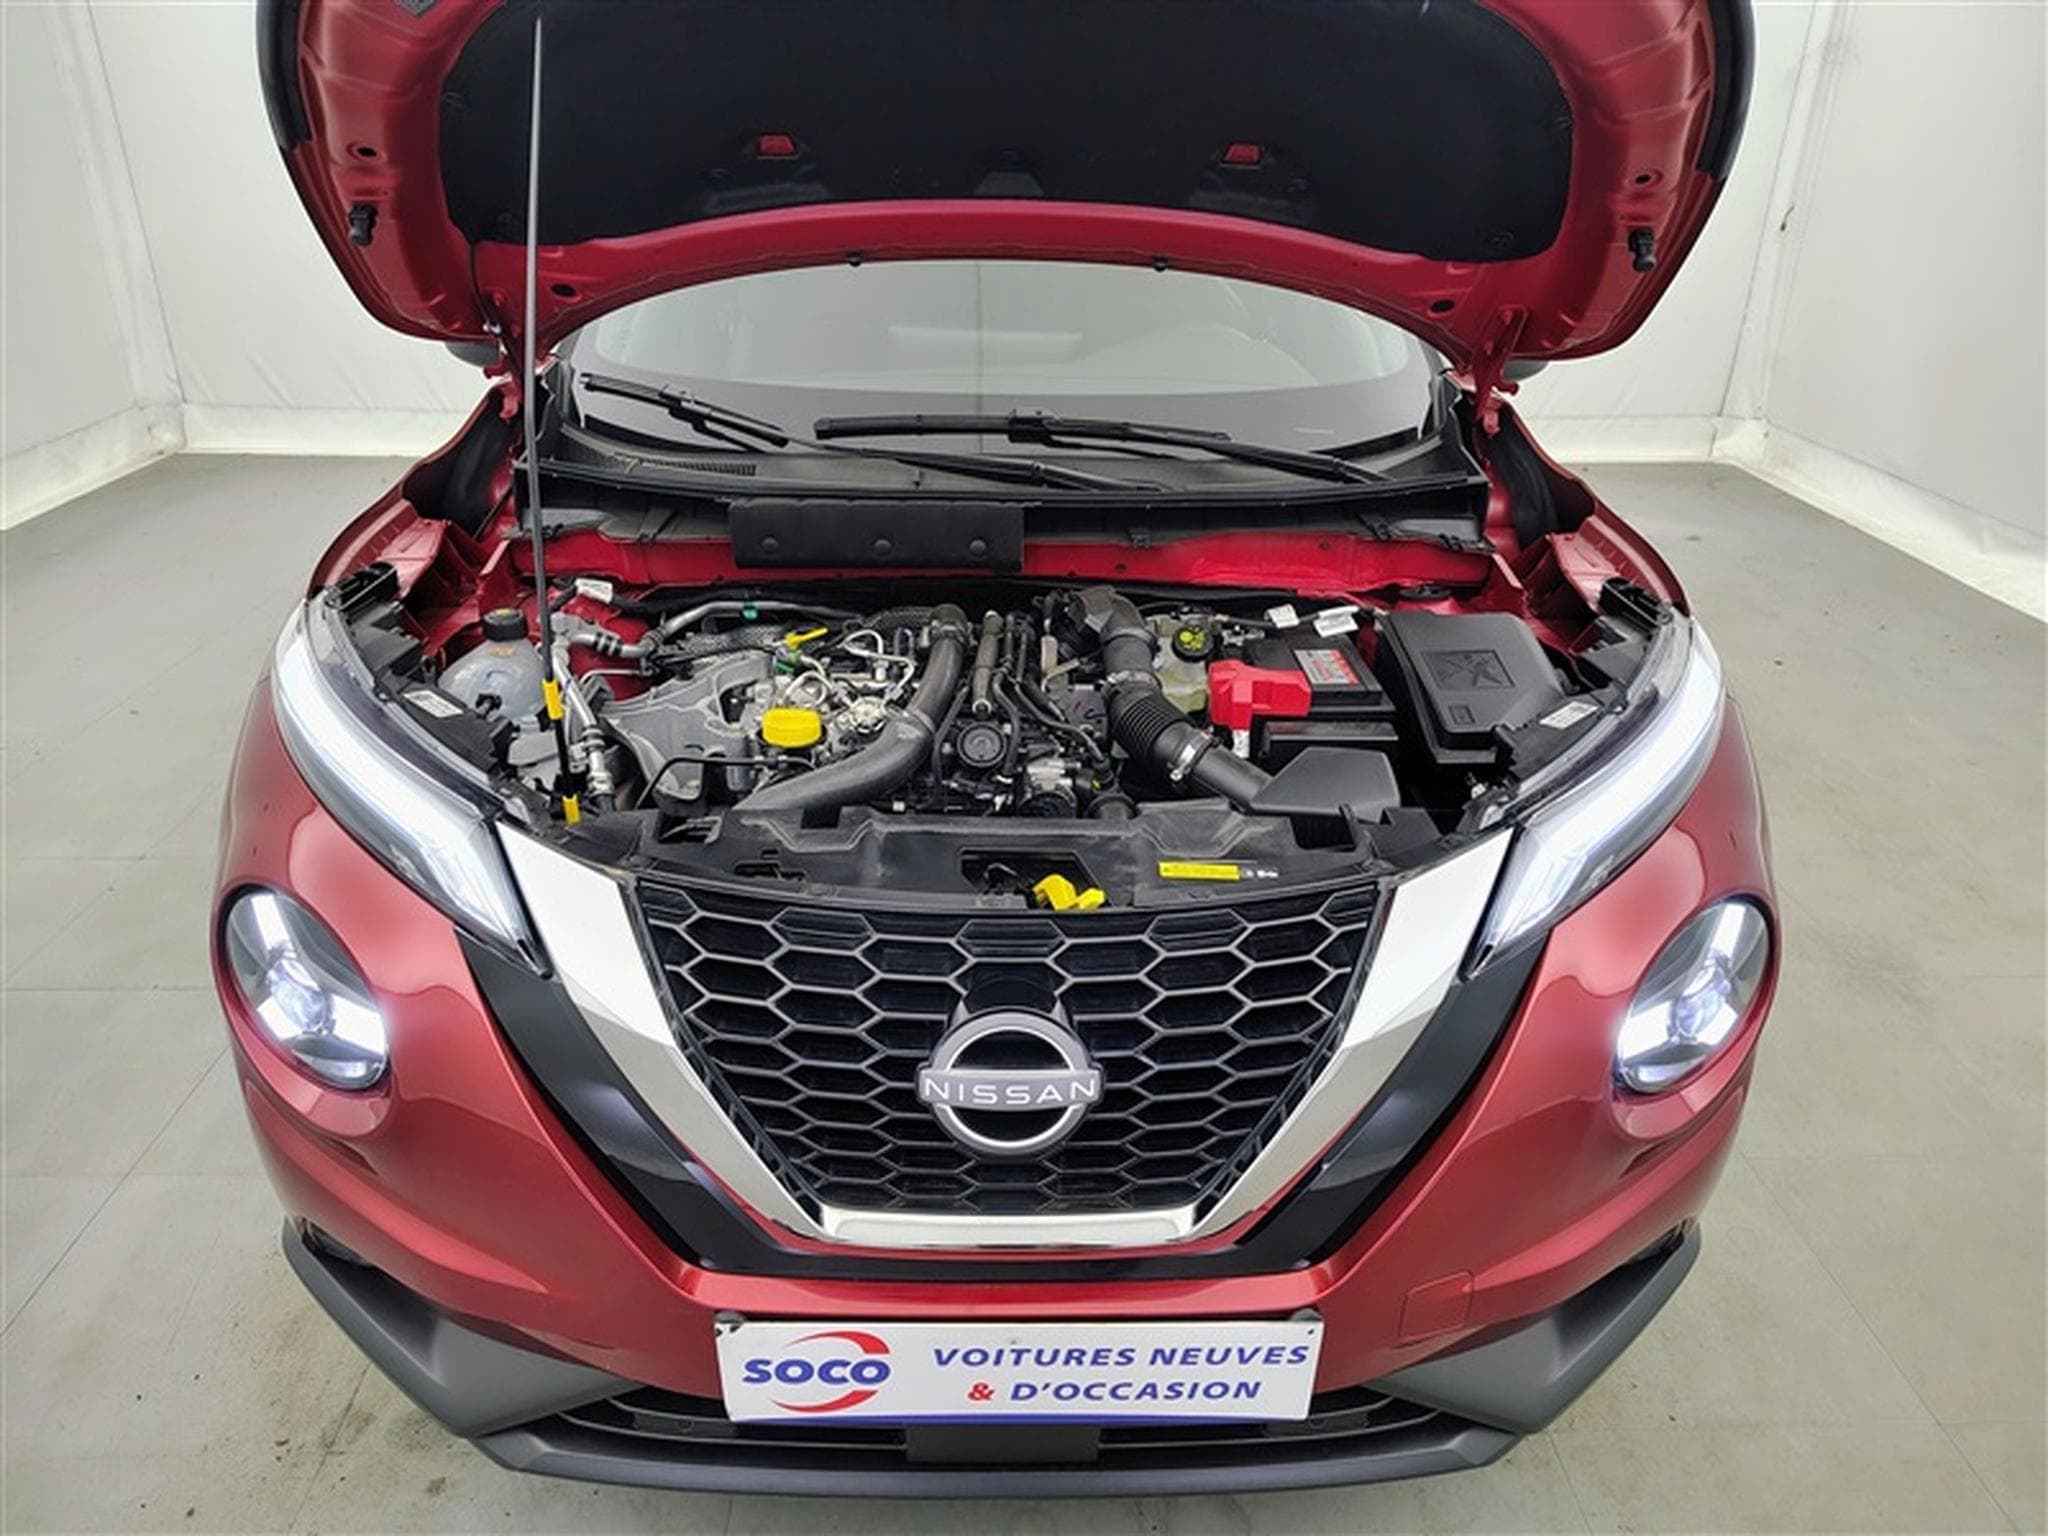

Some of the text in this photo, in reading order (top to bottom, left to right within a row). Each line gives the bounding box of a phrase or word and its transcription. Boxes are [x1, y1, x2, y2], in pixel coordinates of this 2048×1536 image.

[924, 1077, 1096, 1105] NISSAN
[933, 1345, 1309, 1367] VOITURES NEUVES
[742, 1358, 891, 1385] SOCO
[967, 1381, 1262, 1401] & D'OCCASION
